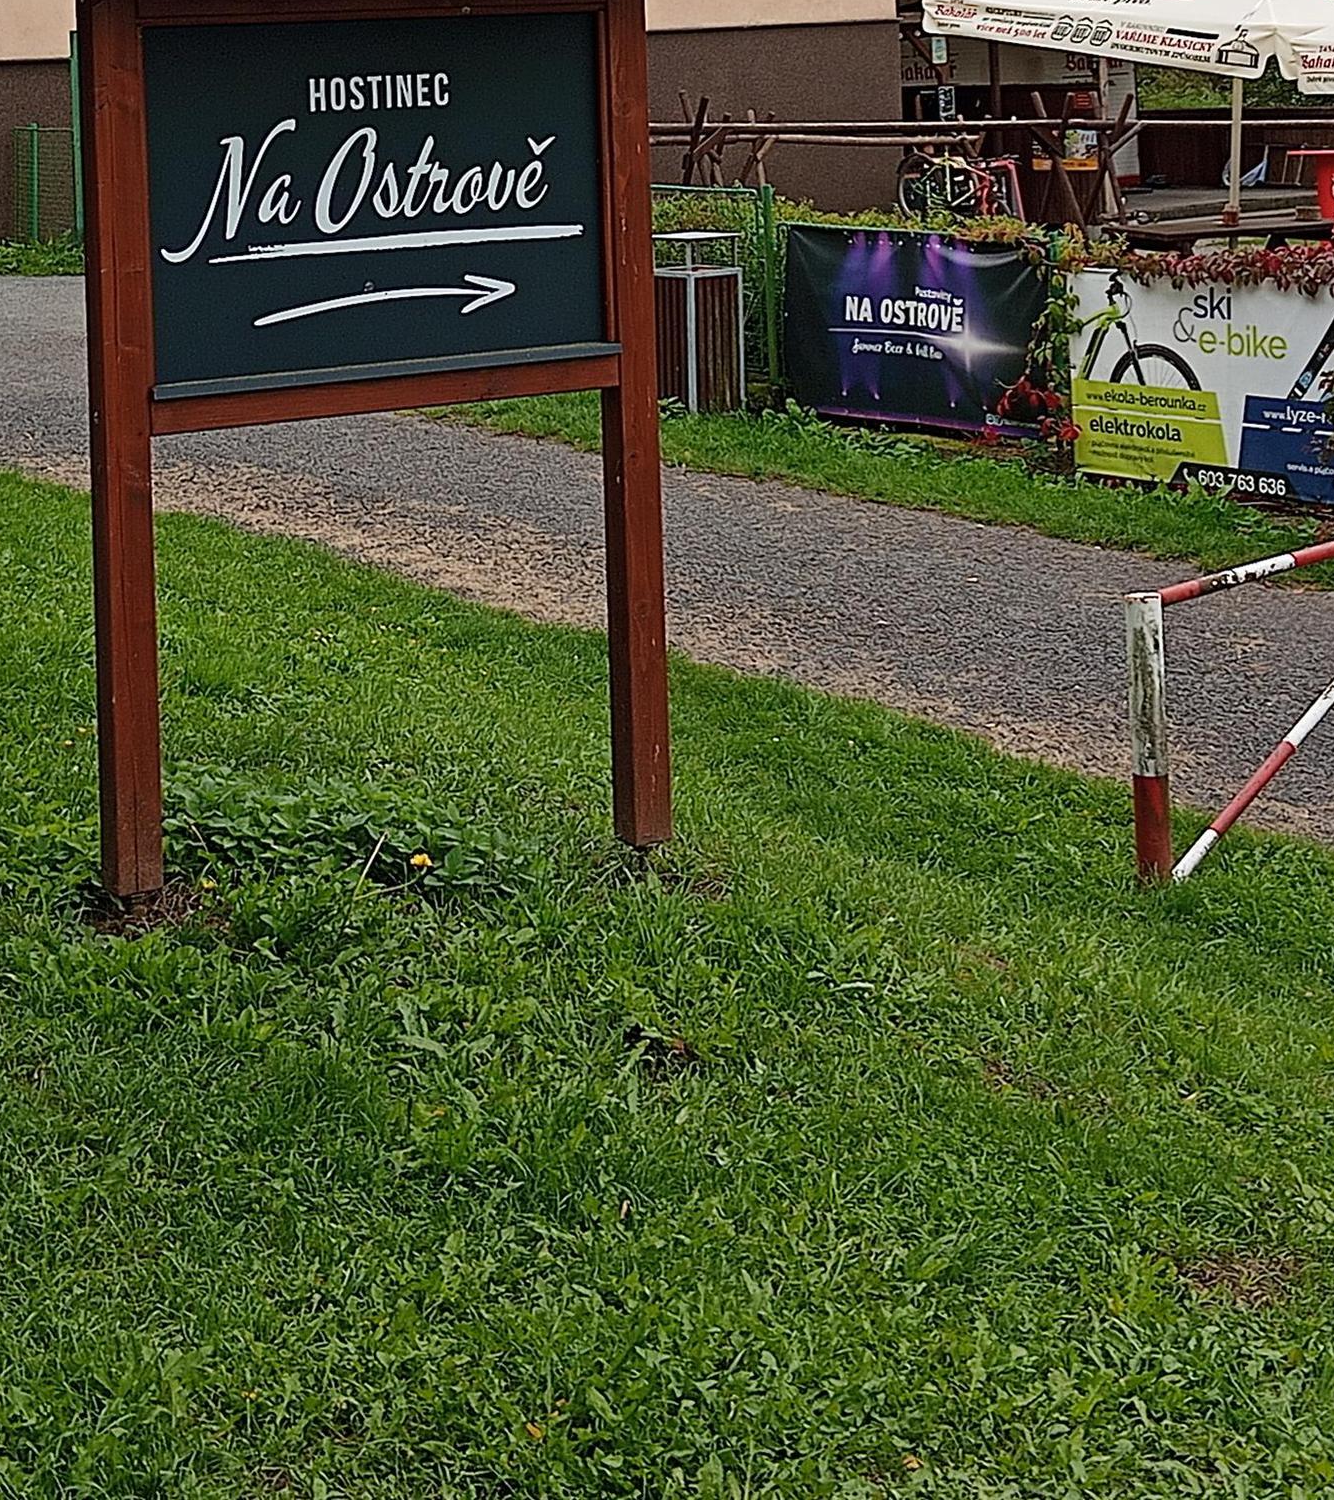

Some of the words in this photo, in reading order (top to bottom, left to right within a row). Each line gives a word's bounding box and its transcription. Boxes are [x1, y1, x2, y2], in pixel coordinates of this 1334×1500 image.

[1159, 36, 1215, 52] KLASICKY
[308, 72, 451, 112] HOSTINEC
[161, 118, 302, 264] Na
[315, 126, 557, 234] Ostrově
[845, 295, 873, 323] NA
[880, 298, 964, 332] OSTROVĚ
[1193, 287, 1232, 320] ski
[1199, 323, 1288, 360] e-bike
[1089, 415, 1182, 443] elektrokola
[1198, 470, 1225, 488] 603
[1228, 473, 1255, 492] 763
[1258, 478, 1286, 496] 636
